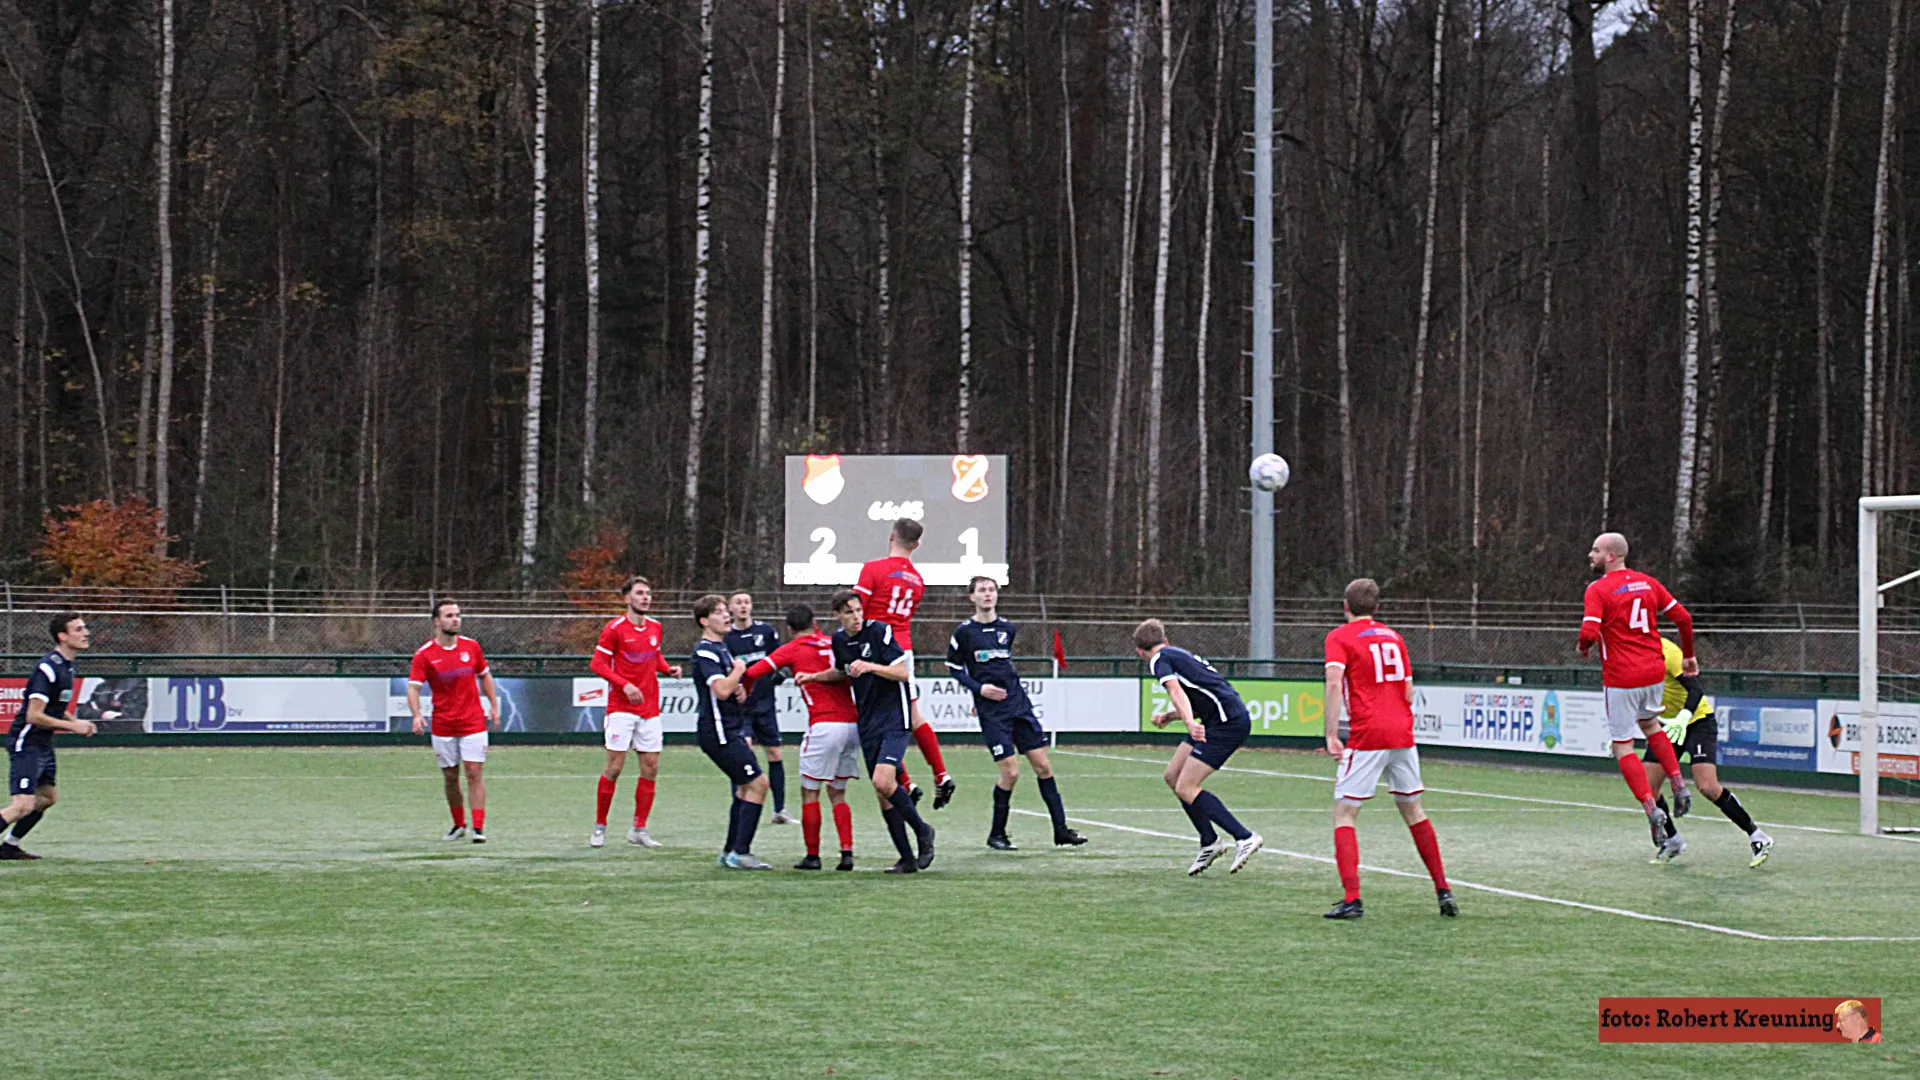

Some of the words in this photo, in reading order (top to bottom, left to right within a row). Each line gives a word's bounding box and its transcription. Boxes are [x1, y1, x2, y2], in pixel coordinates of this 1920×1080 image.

[810, 527, 837, 565] 2
[958, 527, 984, 565] 1
[1629, 598, 1650, 633] 4
[1369, 642, 1405, 683] 19
[168, 678, 226, 731] TB
[660, 696, 698, 714] HO
